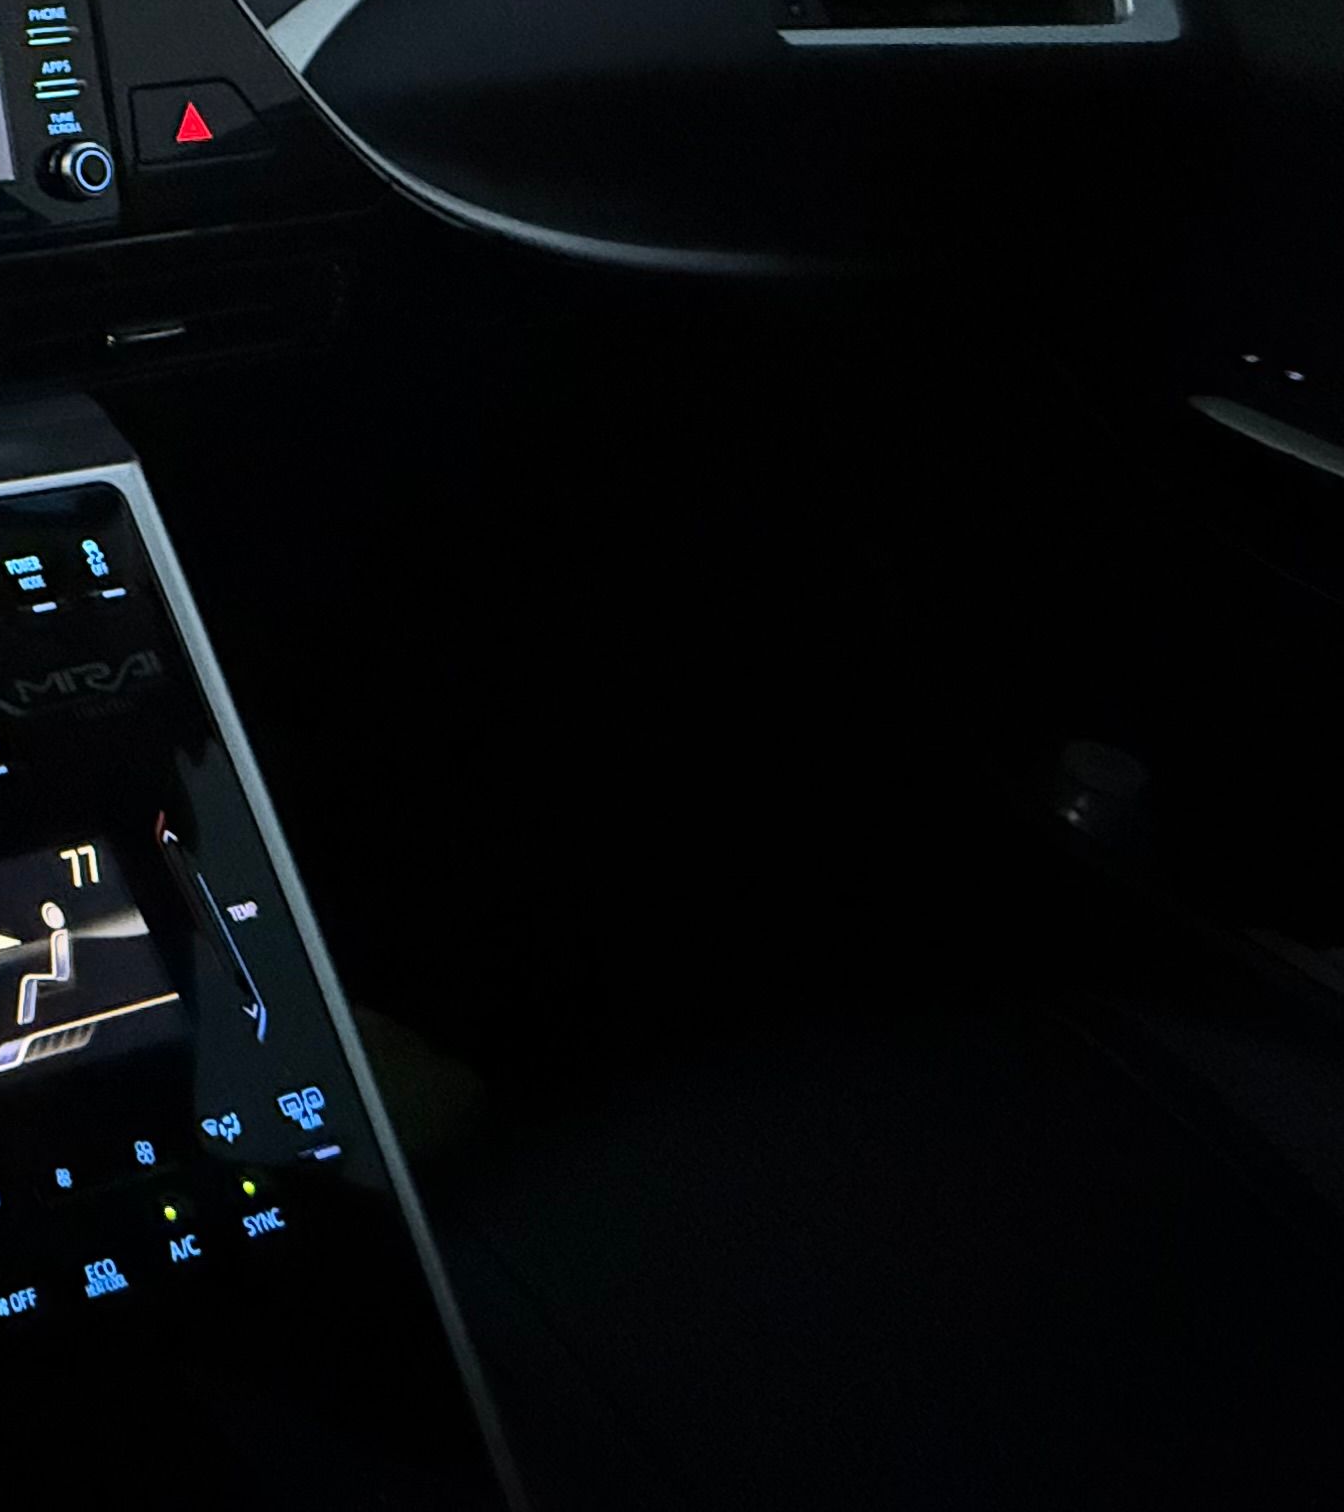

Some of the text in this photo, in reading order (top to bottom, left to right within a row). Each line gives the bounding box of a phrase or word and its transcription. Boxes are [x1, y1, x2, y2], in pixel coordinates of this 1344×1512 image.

[28, 7, 67, 21] PHONE
[42, 59, 72, 74] APPS
[48, 122, 82, 135] SCROLL
[60, 844, 100, 888] 77
[226, 900, 259, 923] TEMP
[242, 1207, 286, 1237] SYNC
[169, 1234, 201, 1263] A/C
[84, 1258, 117, 1284] ECO
[9, 1287, 38, 1313] OFF
